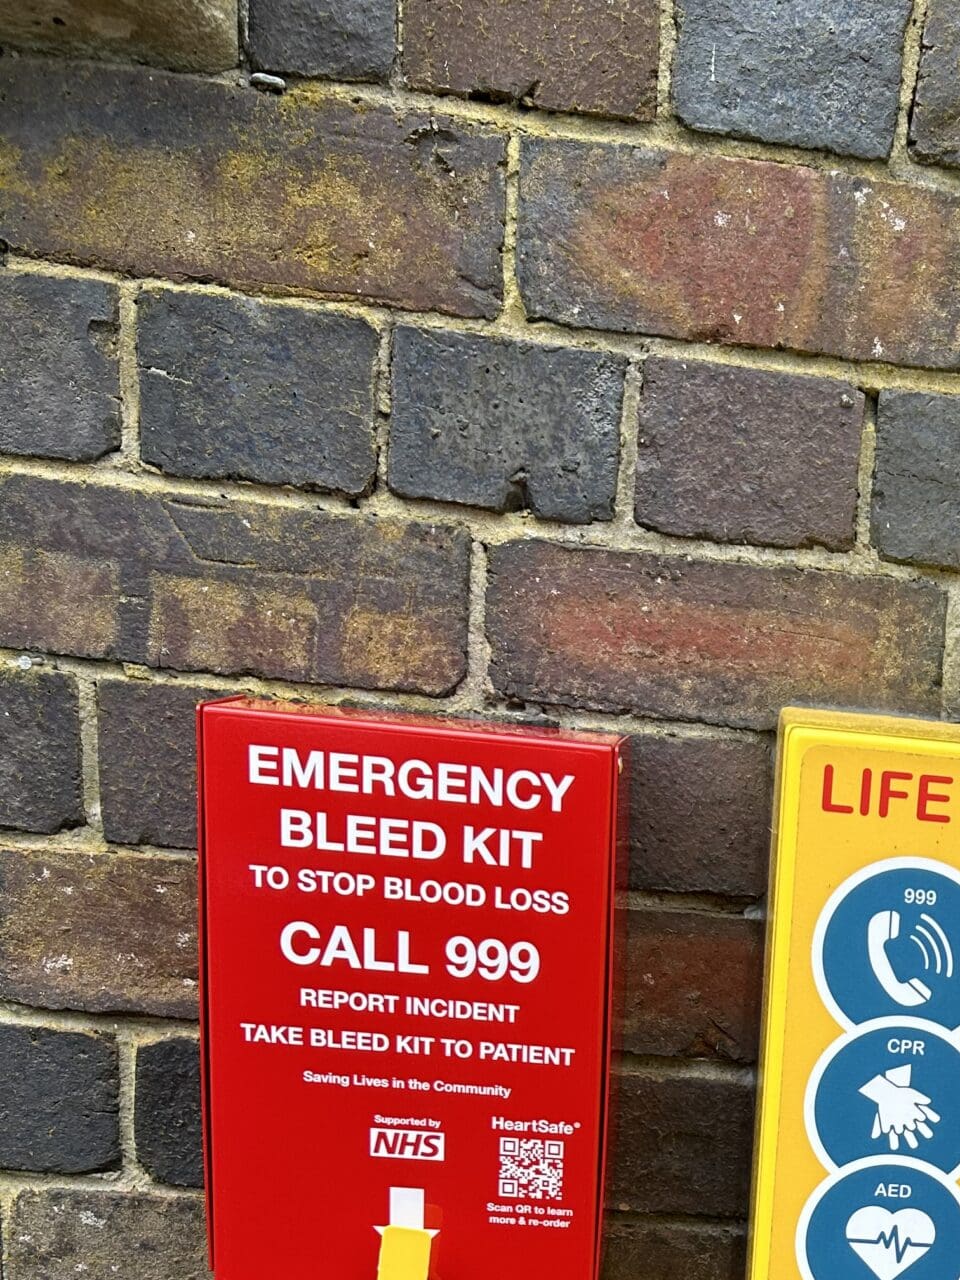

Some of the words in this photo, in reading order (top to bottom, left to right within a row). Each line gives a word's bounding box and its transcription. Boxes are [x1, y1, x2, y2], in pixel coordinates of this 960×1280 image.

[247, 744, 576, 813] EMERGENCY
[821, 764, 954, 823] LIFE
[280, 808, 447, 860] BLEED
[463, 825, 543, 869] KIT
[249, 864, 289, 890] TO
[297, 869, 375, 897] STOP
[384, 878, 486, 907] BLOOD
[495, 887, 570, 915] LOSS
[904, 888, 937, 906] 999
[279, 921, 429, 974] CALL
[445, 935, 540, 984] 999
[299, 988, 399, 1014] REPORT
[405, 996, 520, 1022] INCIDENT
[240, 1023, 303, 1046] TAKE
[310, 1028, 389, 1052] BLEED
[396, 1034, 431, 1055] KIT
[441, 1038, 473, 1060] TO
[479, 1042, 576, 1067] PATIENT
[887, 1038, 925, 1056] CPR
[303, 1071, 350, 1088] Saving
[353, 1075, 389, 1089] Lives
[392, 1077, 405, 1089] in
[408, 1078, 430, 1091] the
[433, 1080, 511, 1099] Community
[374, 1114, 426, 1128] Supported
[427, 1117, 441, 1129] by
[373, 1131, 442, 1158] NHS
[874, 1183, 912, 1198] AED
[486, 1202, 513, 1213] Scan
[515, 1204, 532, 1214] QR
[534, 1206, 545, 1215] to
[546, 1206, 574, 1217] learn
[489, 1216, 516, 1225] more
[518, 1216, 526, 1226] &
[528, 1218, 571, 1228] re-order
